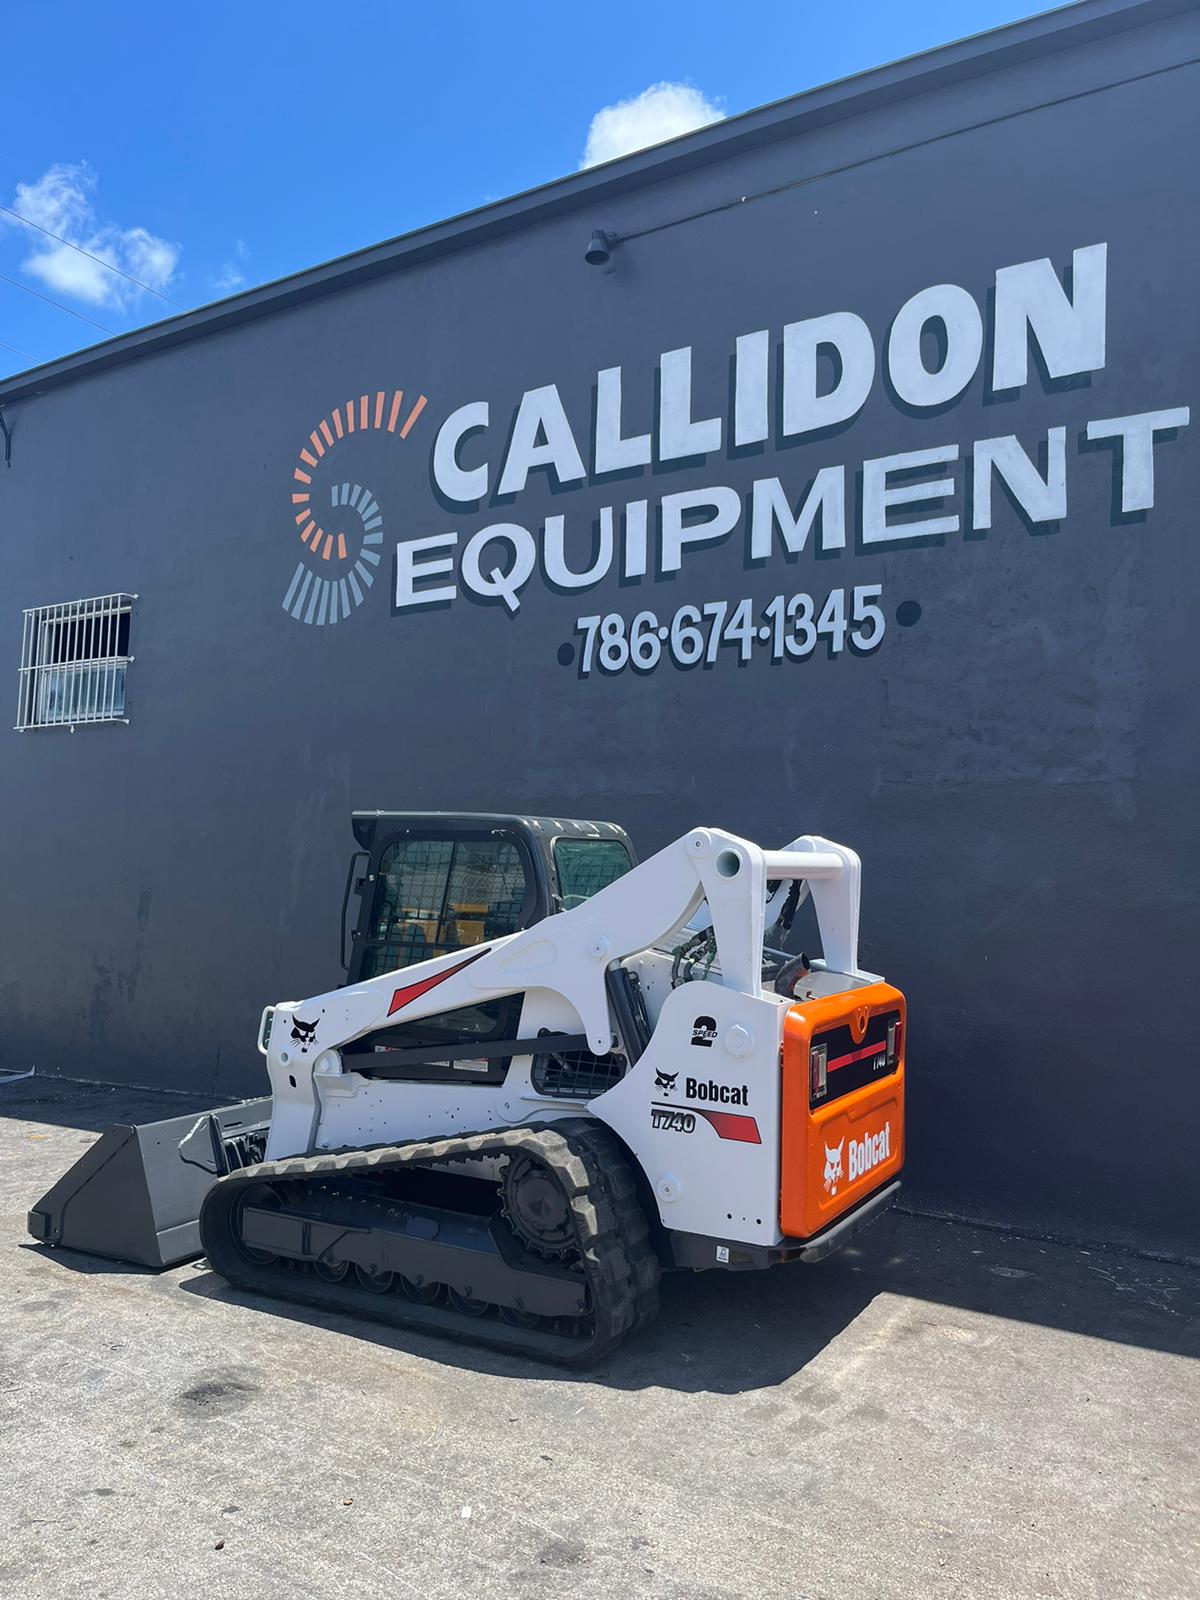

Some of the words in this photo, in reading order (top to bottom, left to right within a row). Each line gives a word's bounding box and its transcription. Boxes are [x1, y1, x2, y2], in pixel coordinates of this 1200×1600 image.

[432, 242, 1108, 503] CALLIDON
[394, 406, 1191, 611] EQUIPMENT
[691, 1015, 717, 1047] 2
[692, 1029, 718, 1039] SPEED
[685, 1077, 749, 1106] Bobcat
[651, 1108, 696, 1134] T740
[848, 1121, 890, 1182] Bobcat
